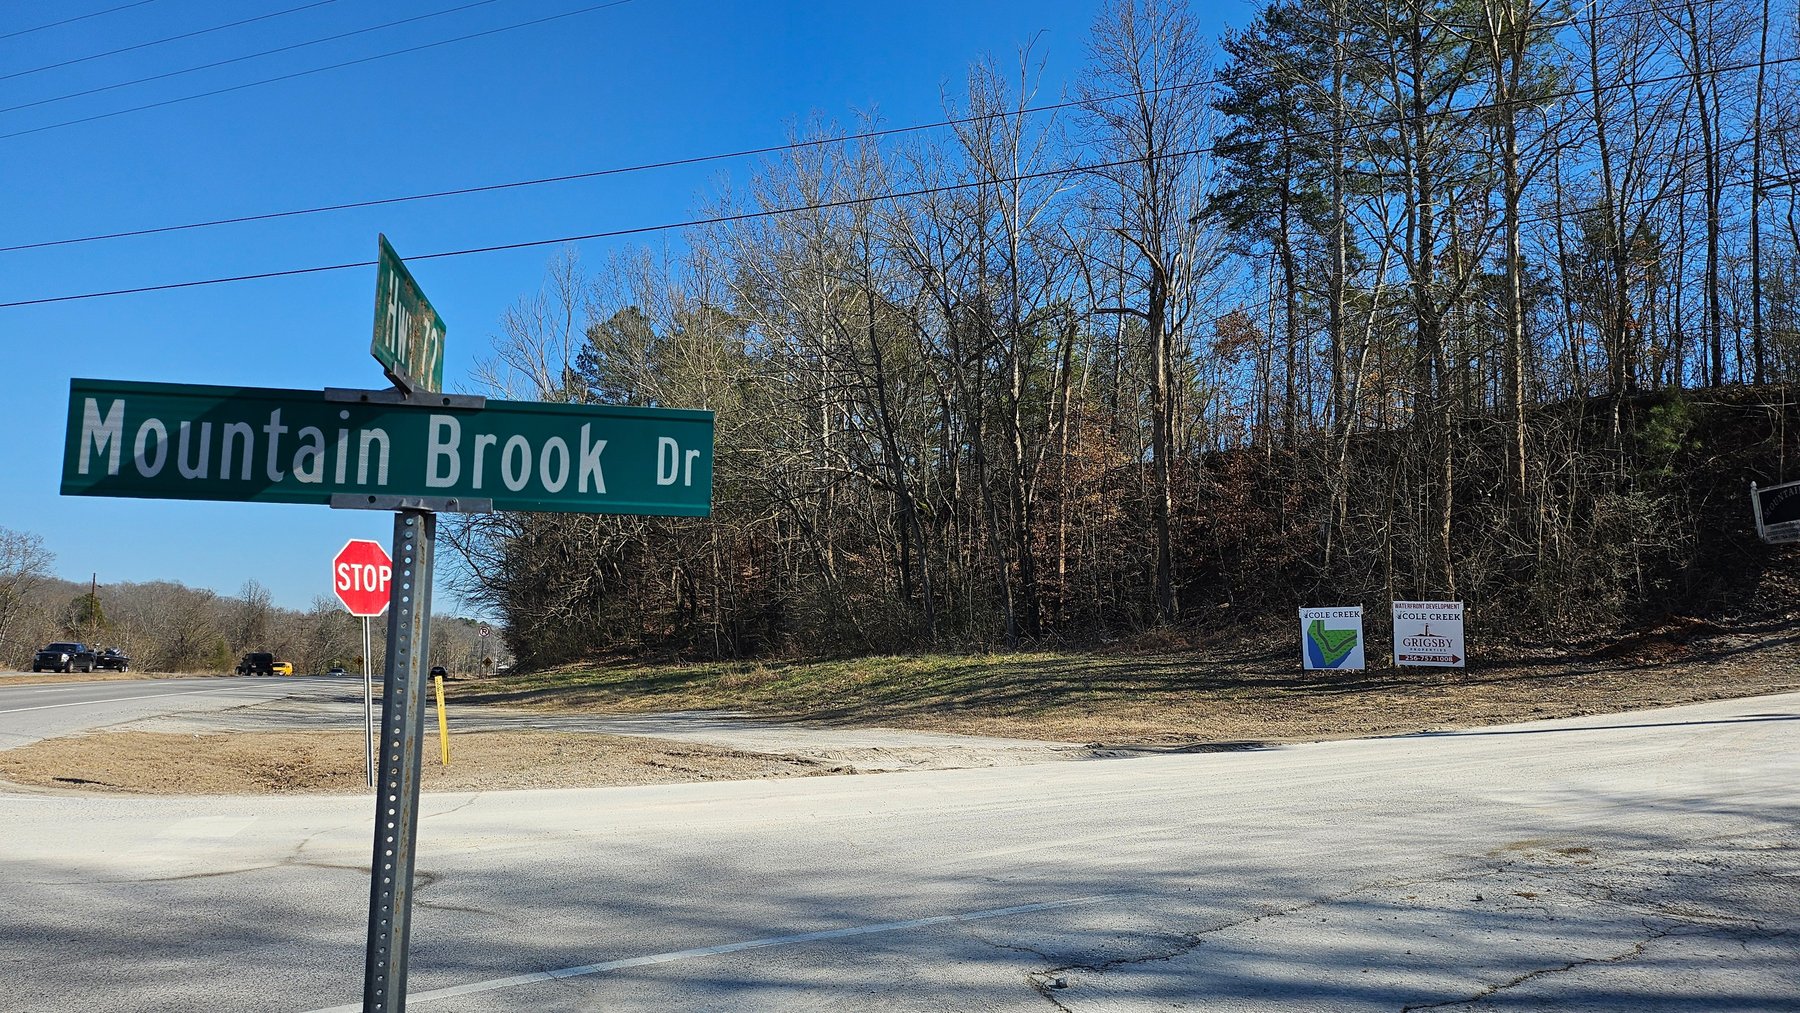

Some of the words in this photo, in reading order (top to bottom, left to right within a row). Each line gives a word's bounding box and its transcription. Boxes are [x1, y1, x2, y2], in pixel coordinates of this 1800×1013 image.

[78, 397, 390, 486] Mountain
[425, 414, 608, 494] Brook
[656, 436, 700, 487] Dr
[1764, 485, 1800, 519] MOUNTAI
[337, 562, 392, 593] STOP
[1308, 611, 1331, 619] COLE
[1402, 612, 1427, 620] COLE
[1429, 613, 1461, 621] CREEK
[1402, 637, 1453, 648] GRIGSBY
